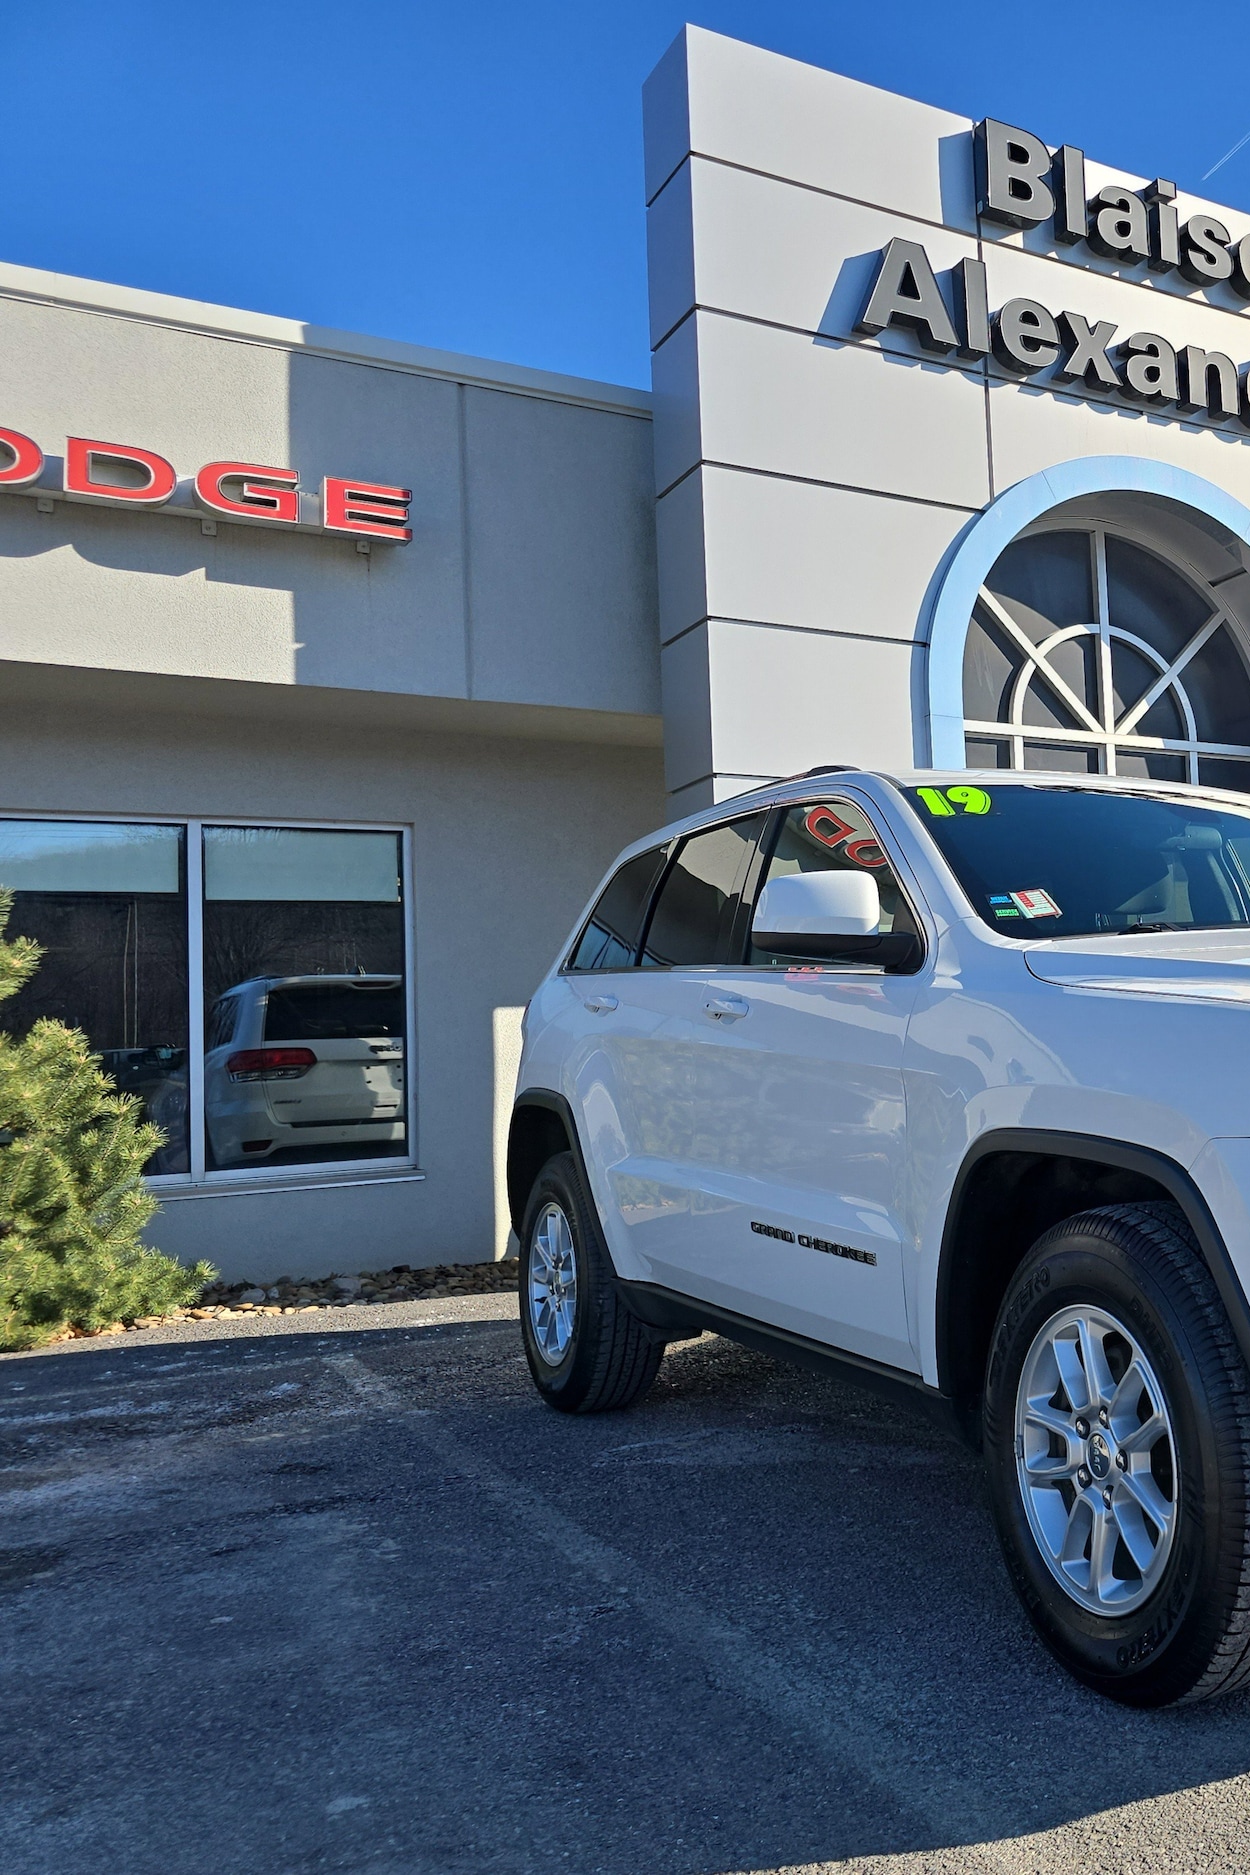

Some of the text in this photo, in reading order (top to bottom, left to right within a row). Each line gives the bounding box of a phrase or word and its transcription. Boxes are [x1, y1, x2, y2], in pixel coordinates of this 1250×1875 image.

[917, 786, 992, 816] 19
[751, 1221, 877, 1266] GRAND CHEROKEE
